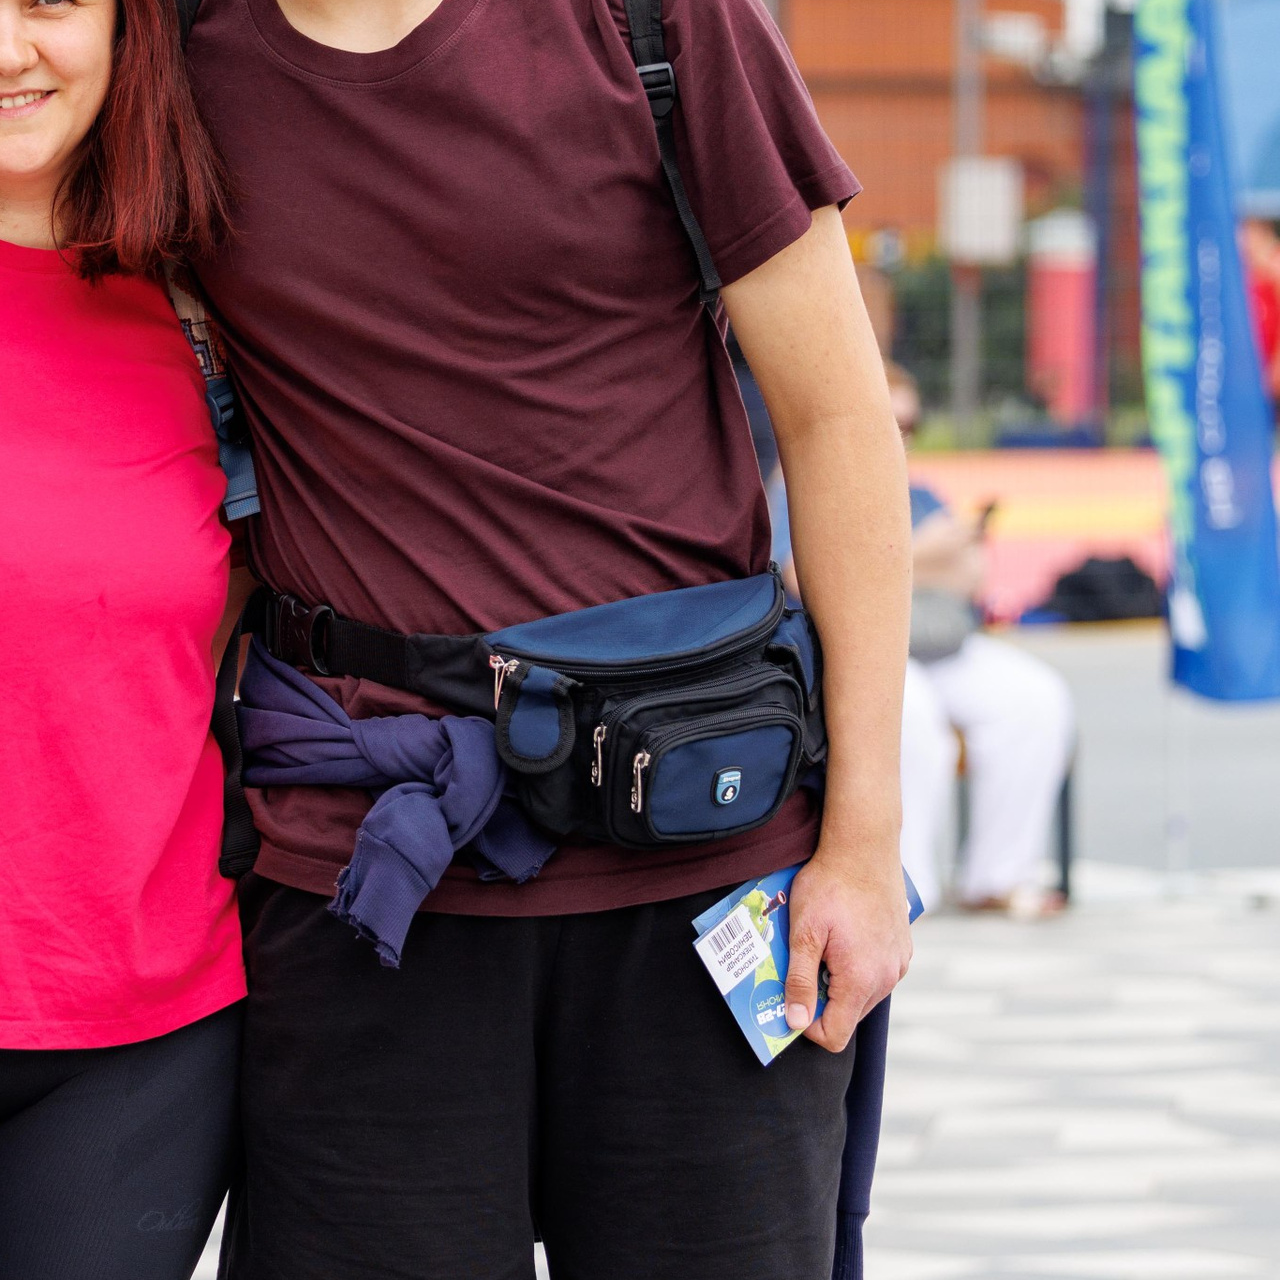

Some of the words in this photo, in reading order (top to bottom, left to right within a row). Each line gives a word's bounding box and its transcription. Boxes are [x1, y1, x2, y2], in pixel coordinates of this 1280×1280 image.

[718, 930, 753, 966] ДЕНИСОВИЧ
[726, 942, 755, 972] АЛЕКСАНДР
[733, 954, 759, 978] ТИХОНОВ
